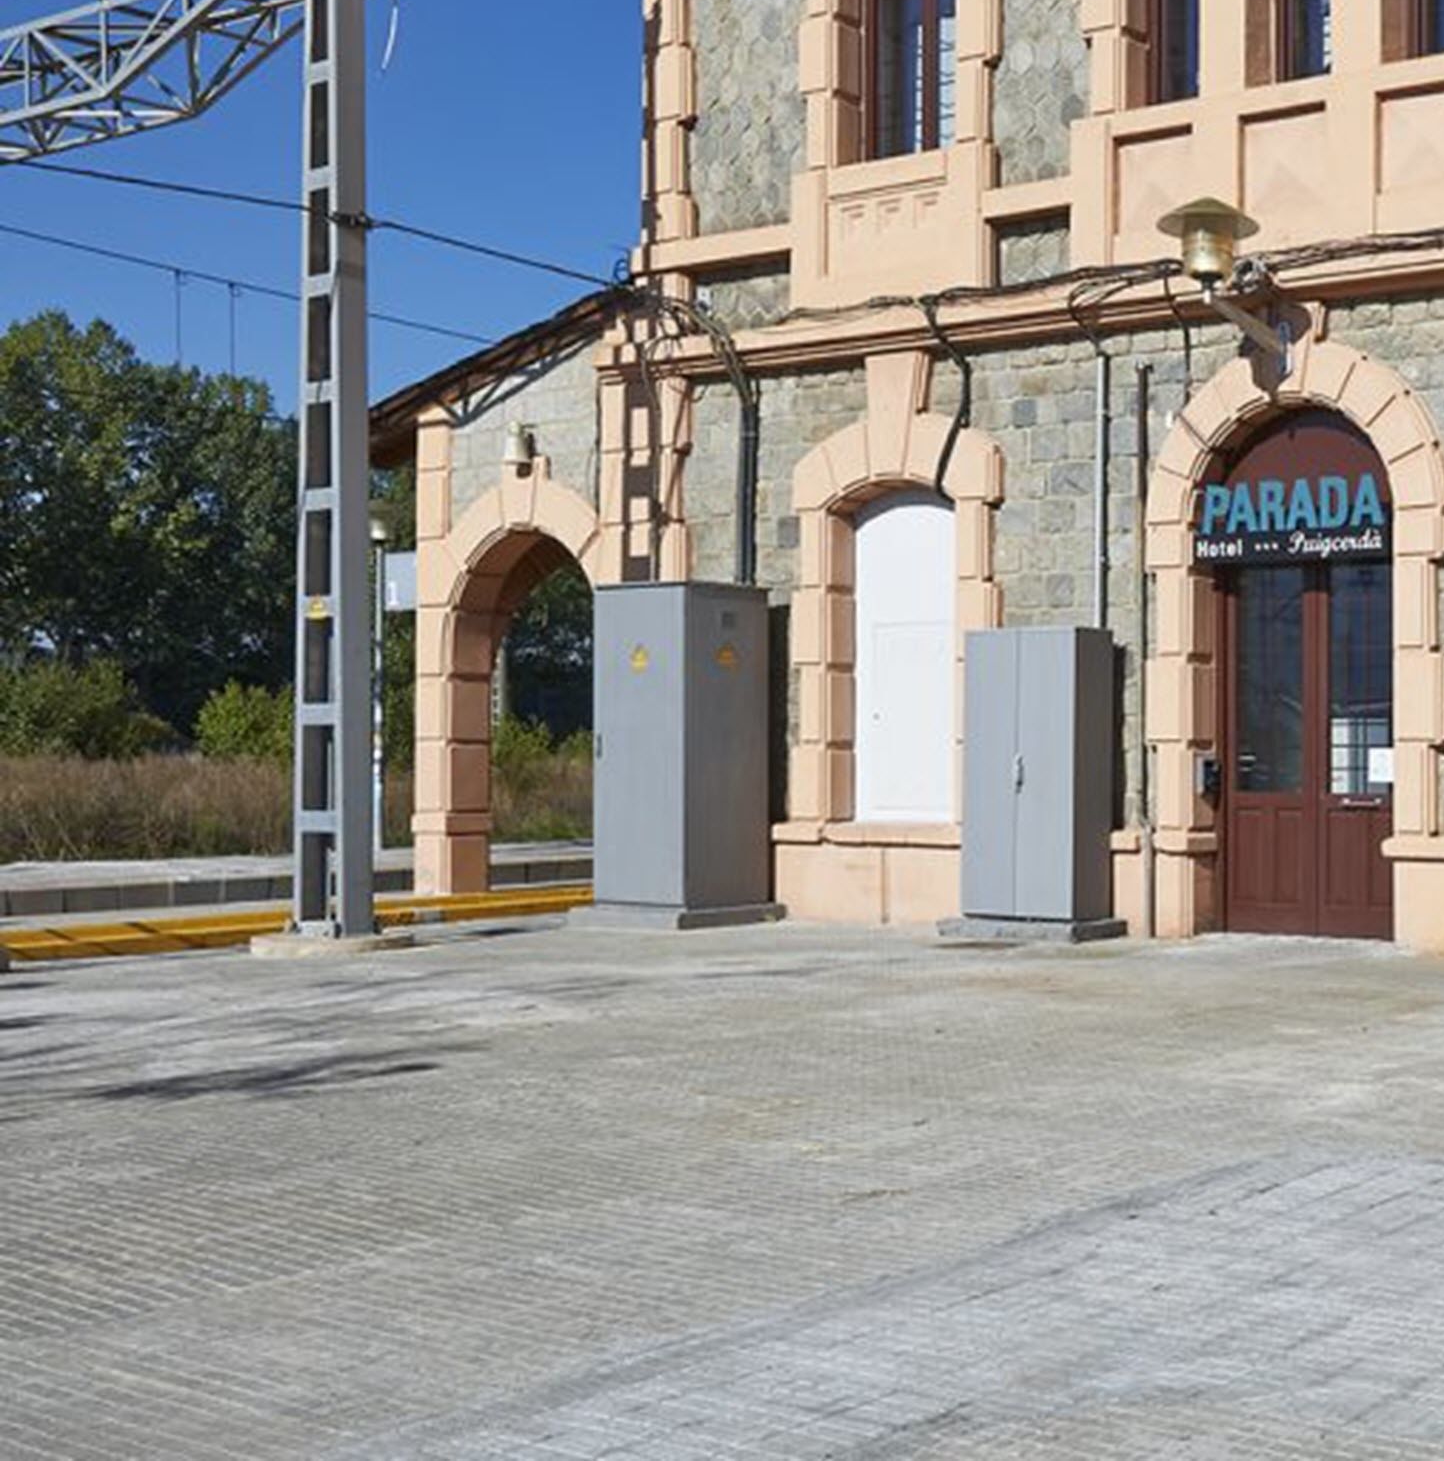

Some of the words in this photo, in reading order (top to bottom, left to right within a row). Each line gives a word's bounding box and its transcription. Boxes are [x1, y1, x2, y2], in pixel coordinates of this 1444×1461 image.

[1203, 474, 1384, 534] PARADA
[1197, 539, 1243, 558] Hotel
[1289, 529, 1382, 558] Puigcerdà
